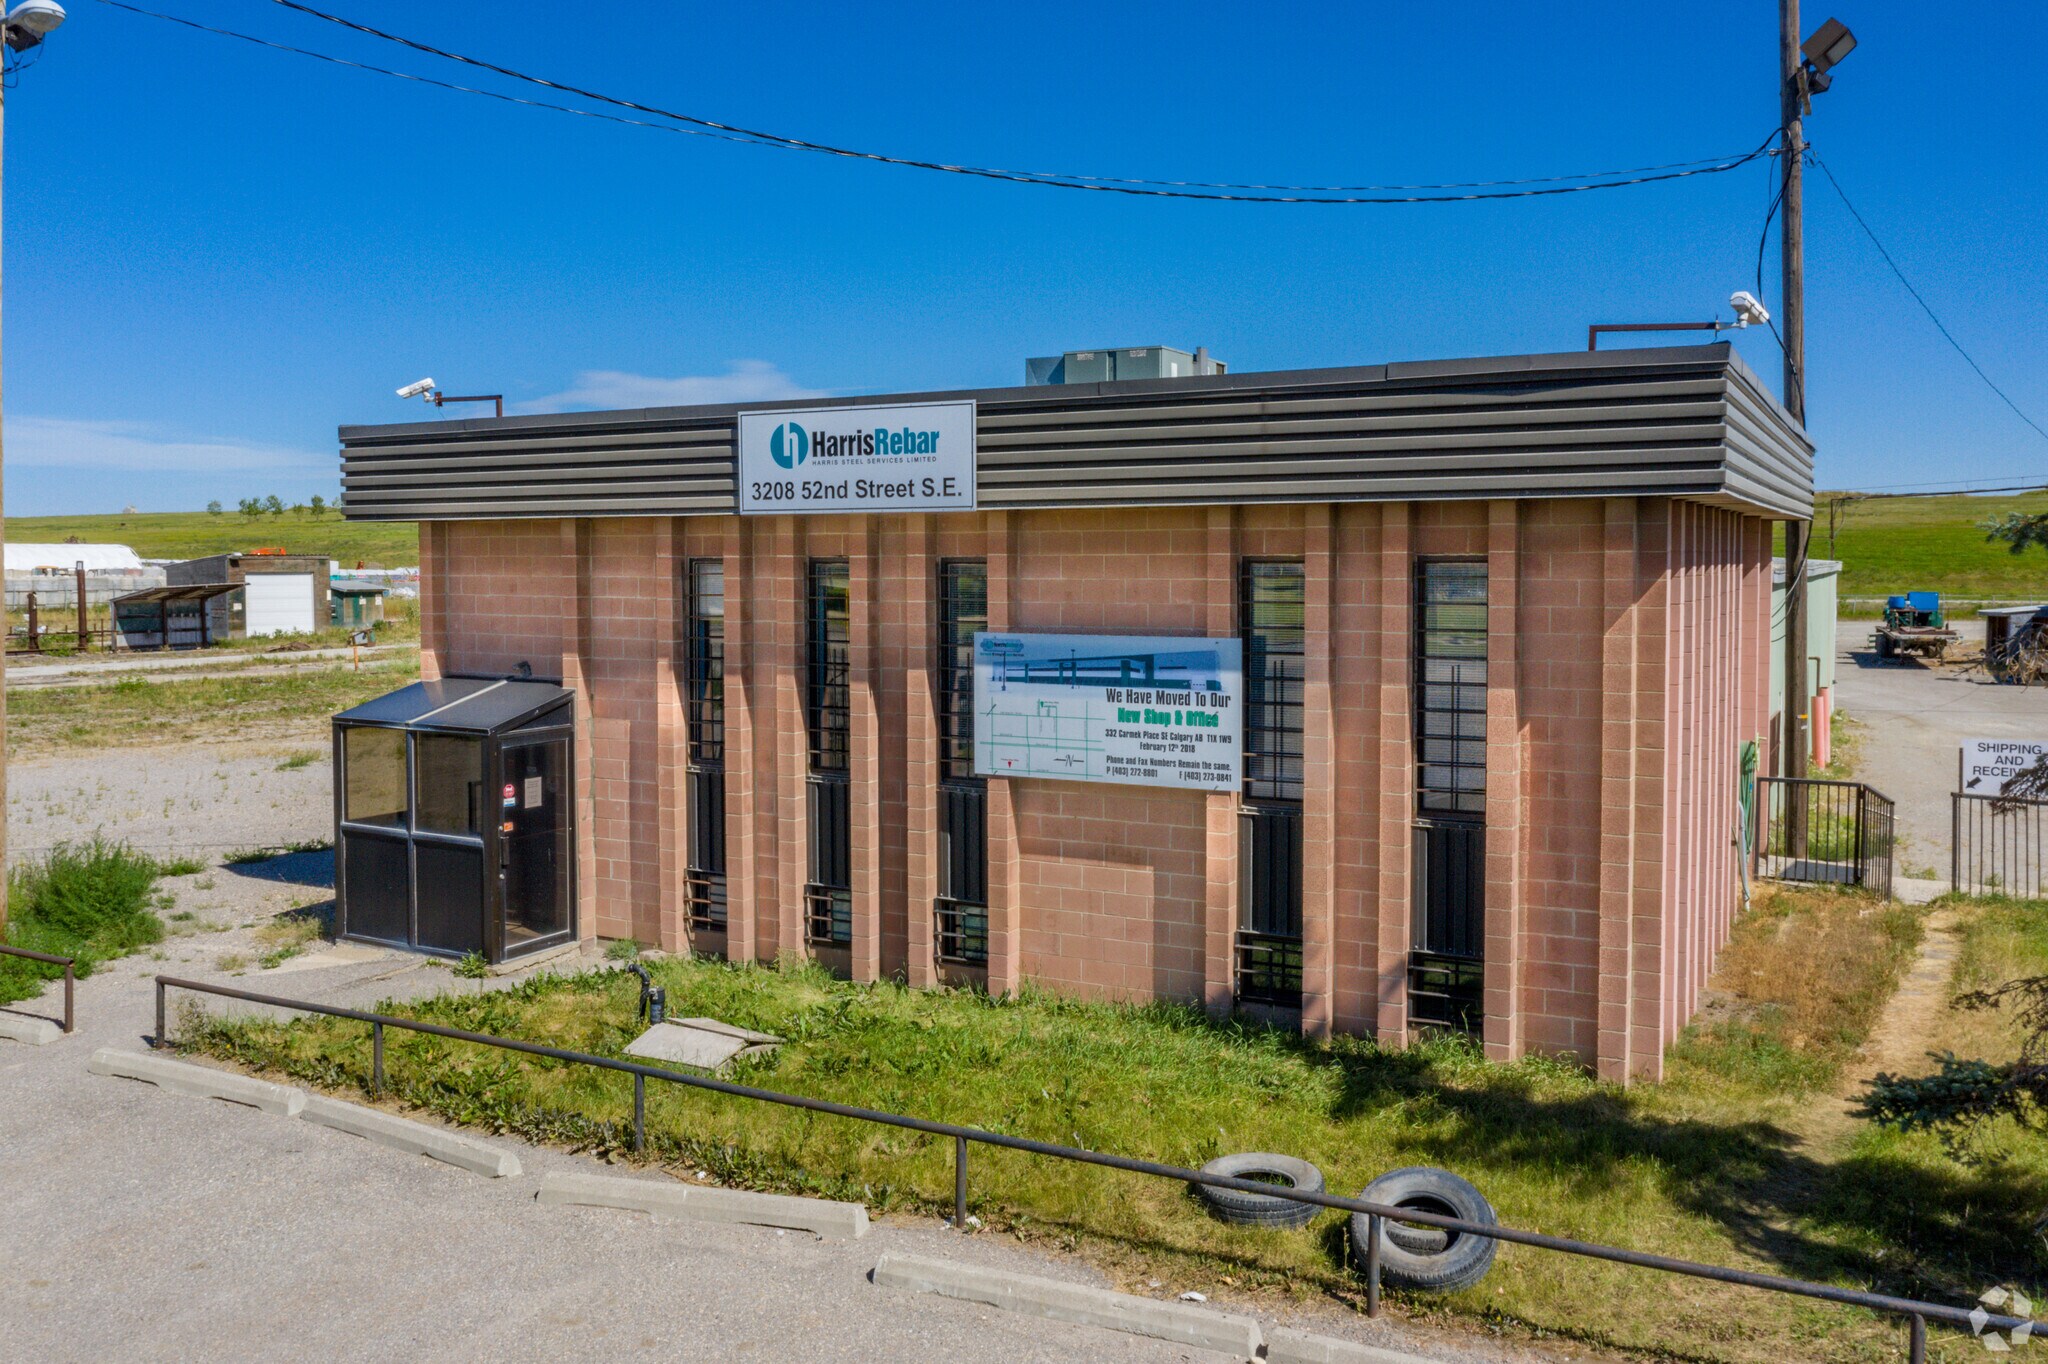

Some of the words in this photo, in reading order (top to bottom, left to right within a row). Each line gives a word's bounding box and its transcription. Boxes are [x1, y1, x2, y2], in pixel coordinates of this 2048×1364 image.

[812, 427, 940, 457] HarrisRebar
[752, 481, 795, 501] 3208
[801, 480, 848, 500] 52nd
[855, 478, 915, 499] Street
[921, 477, 962, 498] S.E.
[1106, 688, 1122, 703] We
[1126, 689, 1152, 705] Have
[1156, 690, 1191, 707] Moved
[1195, 692, 1207, 707] To
[1210, 692, 1231, 708] Our
[1117, 707, 1141, 724] New
[1144, 708, 1171, 728] Shop
[1186, 710, 1219, 727] Office
[1105, 729, 1117, 738] 332
[1118, 729, 1141, 739] Carmek
[1142, 731, 1160, 740] Place
[1160, 731, 1168, 740] SE
[1170, 732, 1193, 743] Calgary
[1194, 734, 1203, 742] AB
[1207, 734, 1218, 743] T1X
[1219, 735, 1232, 744] 1W9
[1139, 741, 1167, 753] February
[1180, 744, 1196, 753] 2018
[1977, 742, 2042, 755] SHIPPING
[1106, 755, 1125, 765] Phone
[1125, 757, 1137, 765] and
[1137, 757, 1149, 766] Fax
[1150, 757, 1177, 768] Numbers
[1178, 760, 1201, 769] Remain
[1201, 761, 1212, 770] the
[1213, 763, 1232, 771] same.
[1994, 755, 2024, 766] AND
[1106, 766, 1111, 775] P
[1179, 770, 1183, 779] F
[1202, 772, 1232, 782] 273-0841
